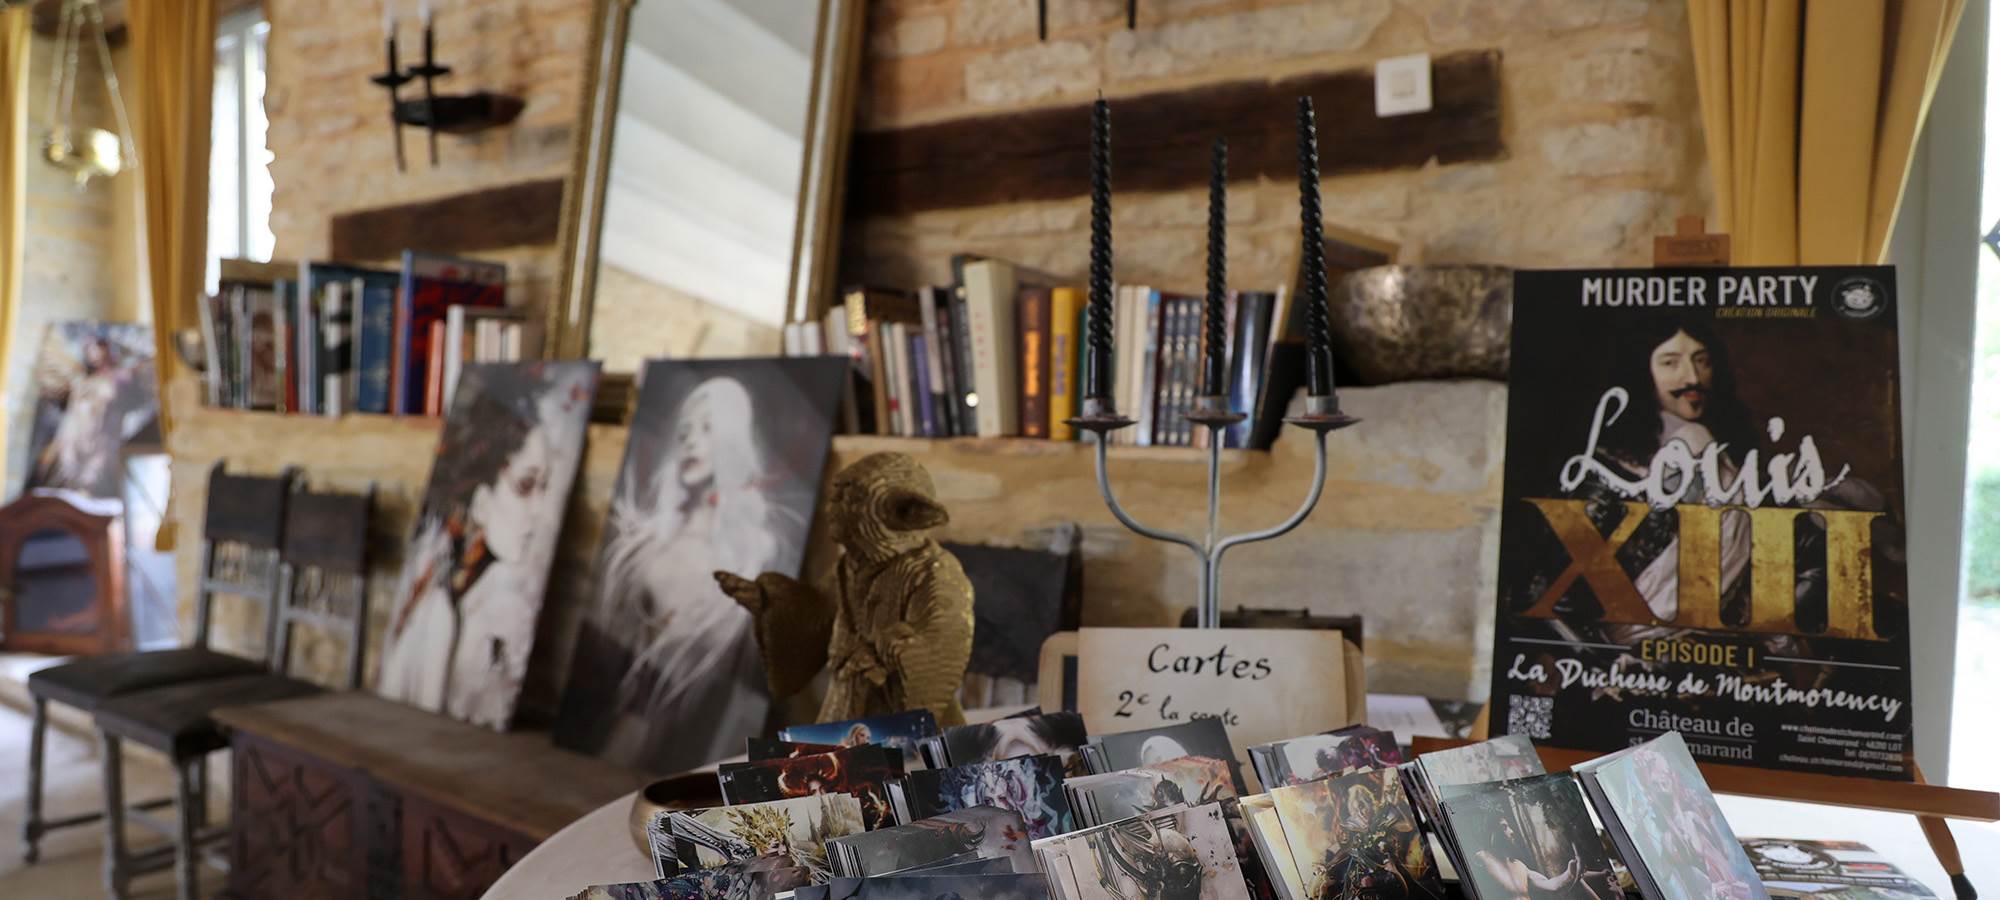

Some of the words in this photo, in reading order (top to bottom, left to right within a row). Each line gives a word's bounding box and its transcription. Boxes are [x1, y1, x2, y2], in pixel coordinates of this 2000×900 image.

[1582, 276, 1706, 306] MURDER
[1718, 275, 1818, 306] PARTY
[1560, 386, 1851, 510] Louis
[1520, 498, 1887, 642] XIII
[1148, 642, 1273, 681] Cartes
[1641, 640, 1738, 667] EPISODE
[1747, 647, 1755, 668] I
[1507, 653, 1548, 682] La
[1556, 658, 1672, 692] Duchesse
[1677, 670, 1709, 695] de
[1716, 673, 1902, 721] Montmorency
[1159, 694, 1180, 720] la
[1629, 708, 1721, 735] Château
[1725, 716, 1754, 737] de
[1888, 743, 1903, 752] LOT
